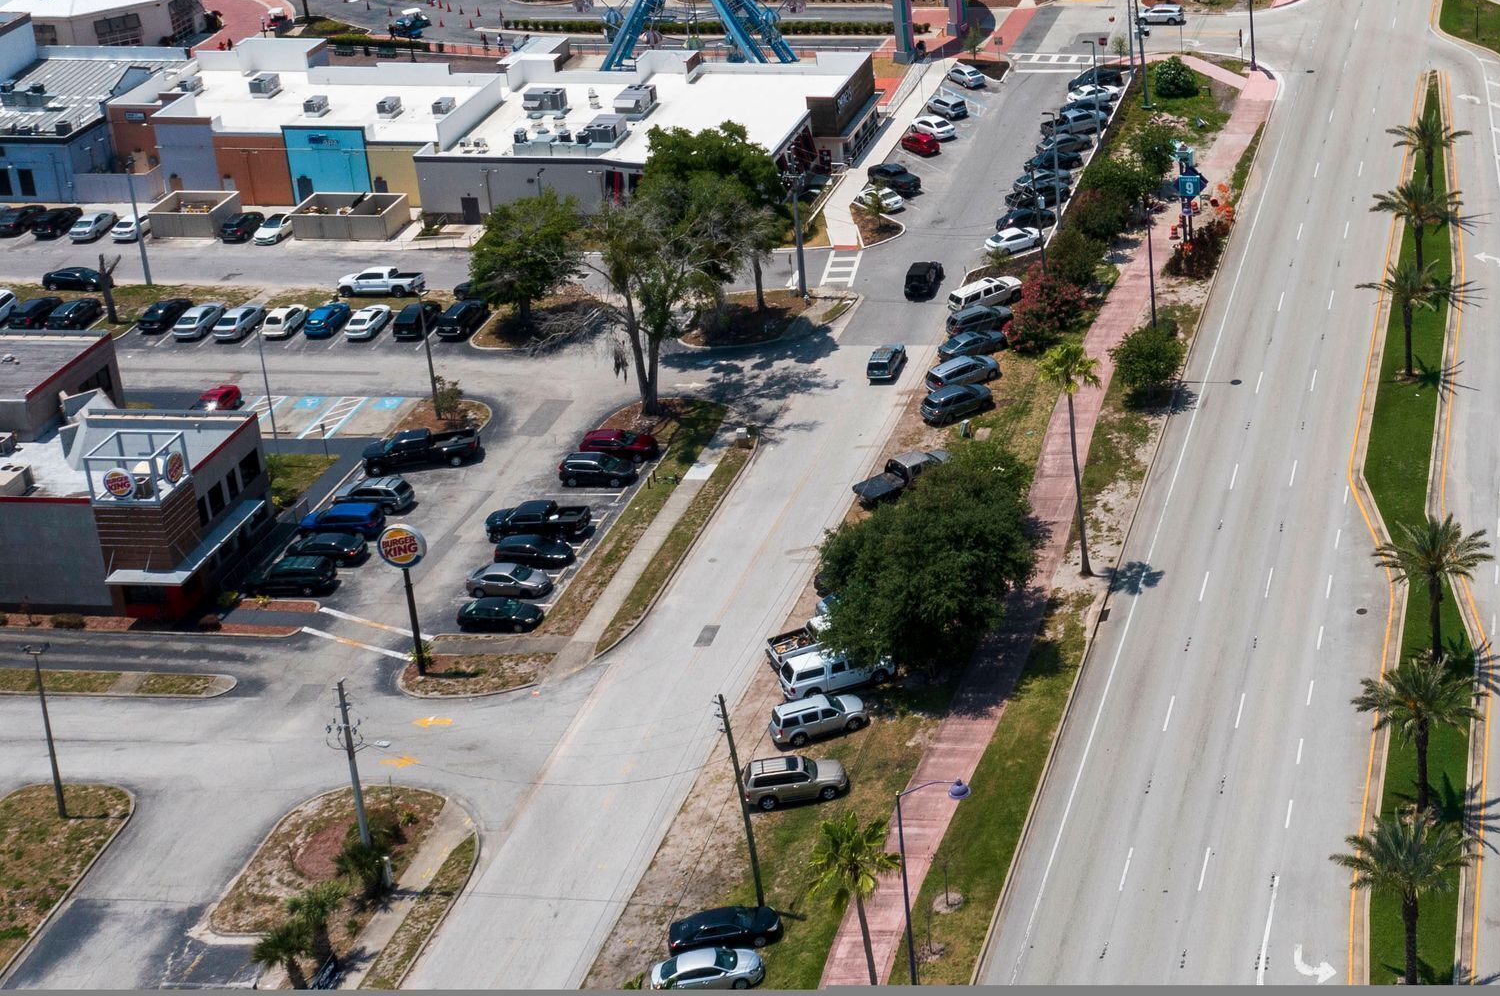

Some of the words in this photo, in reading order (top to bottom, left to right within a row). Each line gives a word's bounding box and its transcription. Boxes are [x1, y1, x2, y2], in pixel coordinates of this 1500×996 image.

[1185, 181, 1194, 194] 9
[106, 475, 129, 483] BURGER
[107, 481, 131, 491] KING
[382, 535, 416, 549] BURGER
[383, 542, 418, 558] KING
